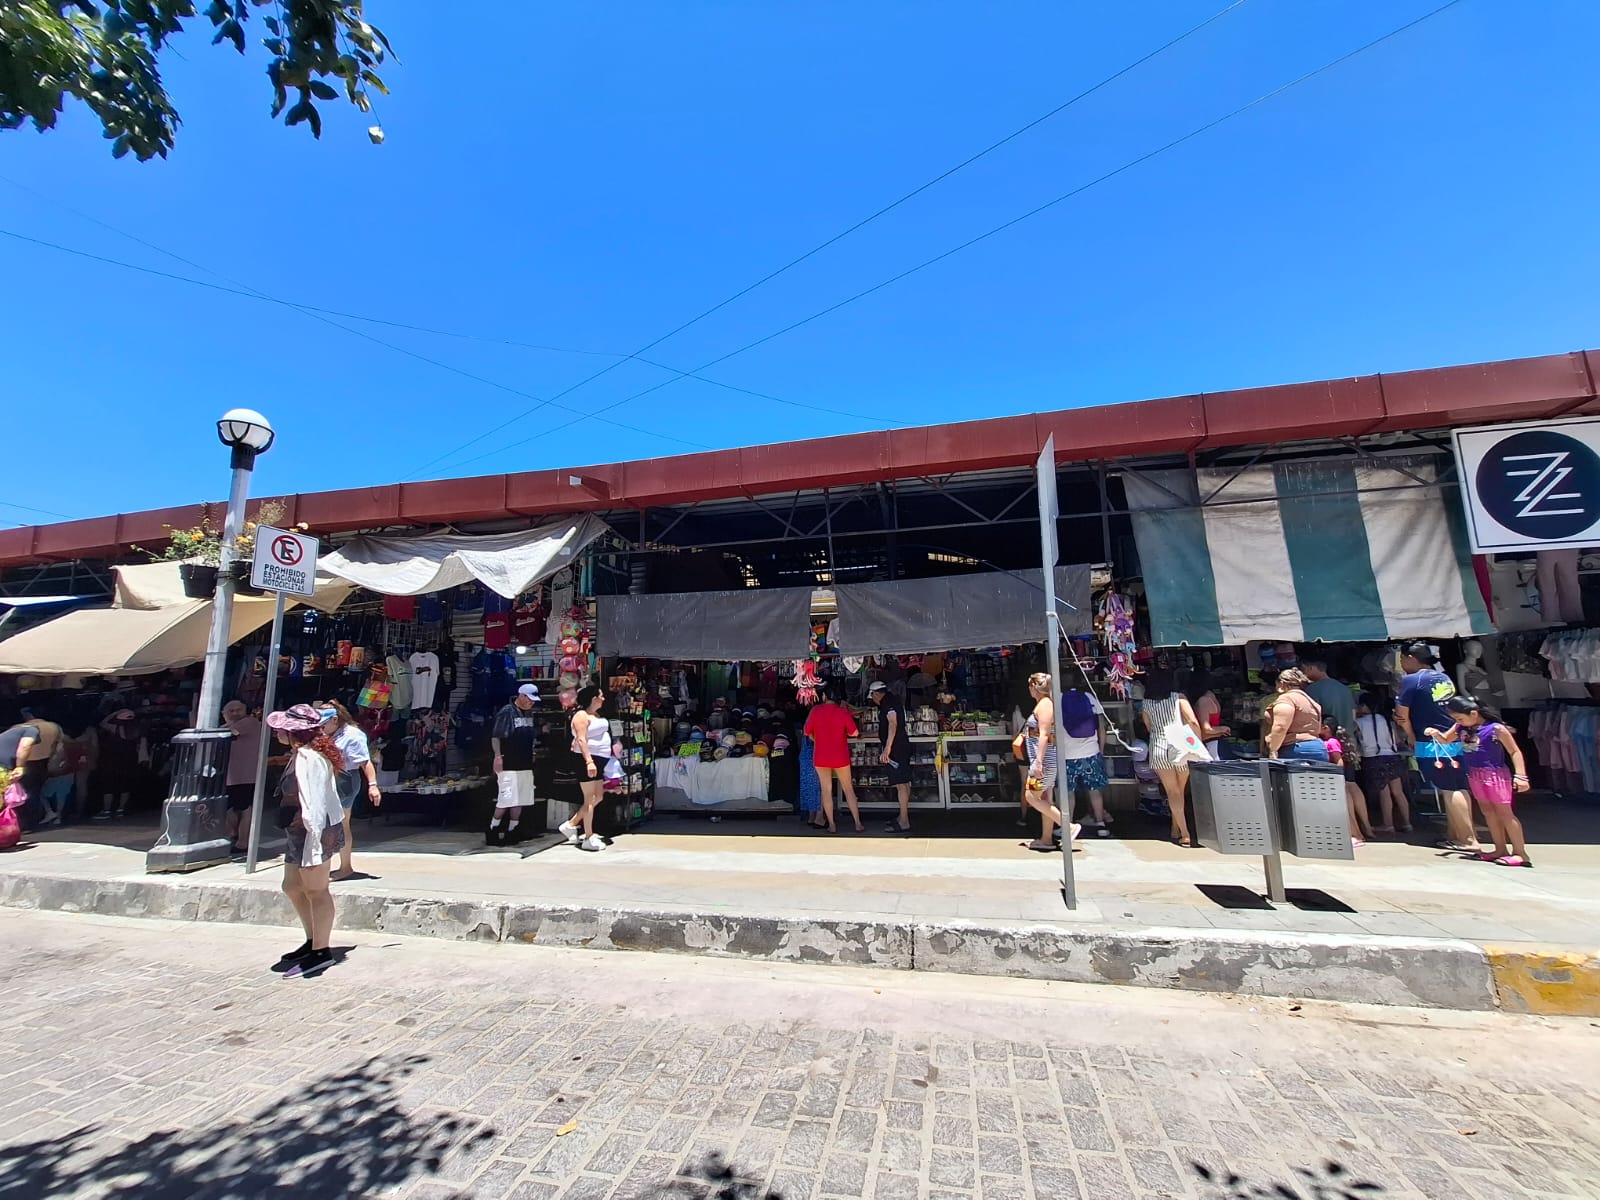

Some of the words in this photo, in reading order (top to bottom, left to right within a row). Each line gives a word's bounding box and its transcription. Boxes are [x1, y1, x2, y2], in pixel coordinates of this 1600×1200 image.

[264, 564, 306, 578] PROHIBIDO
[264, 571, 304, 585] ESTACIONAR
[263, 577, 304, 591] MOTOCICLETAS
